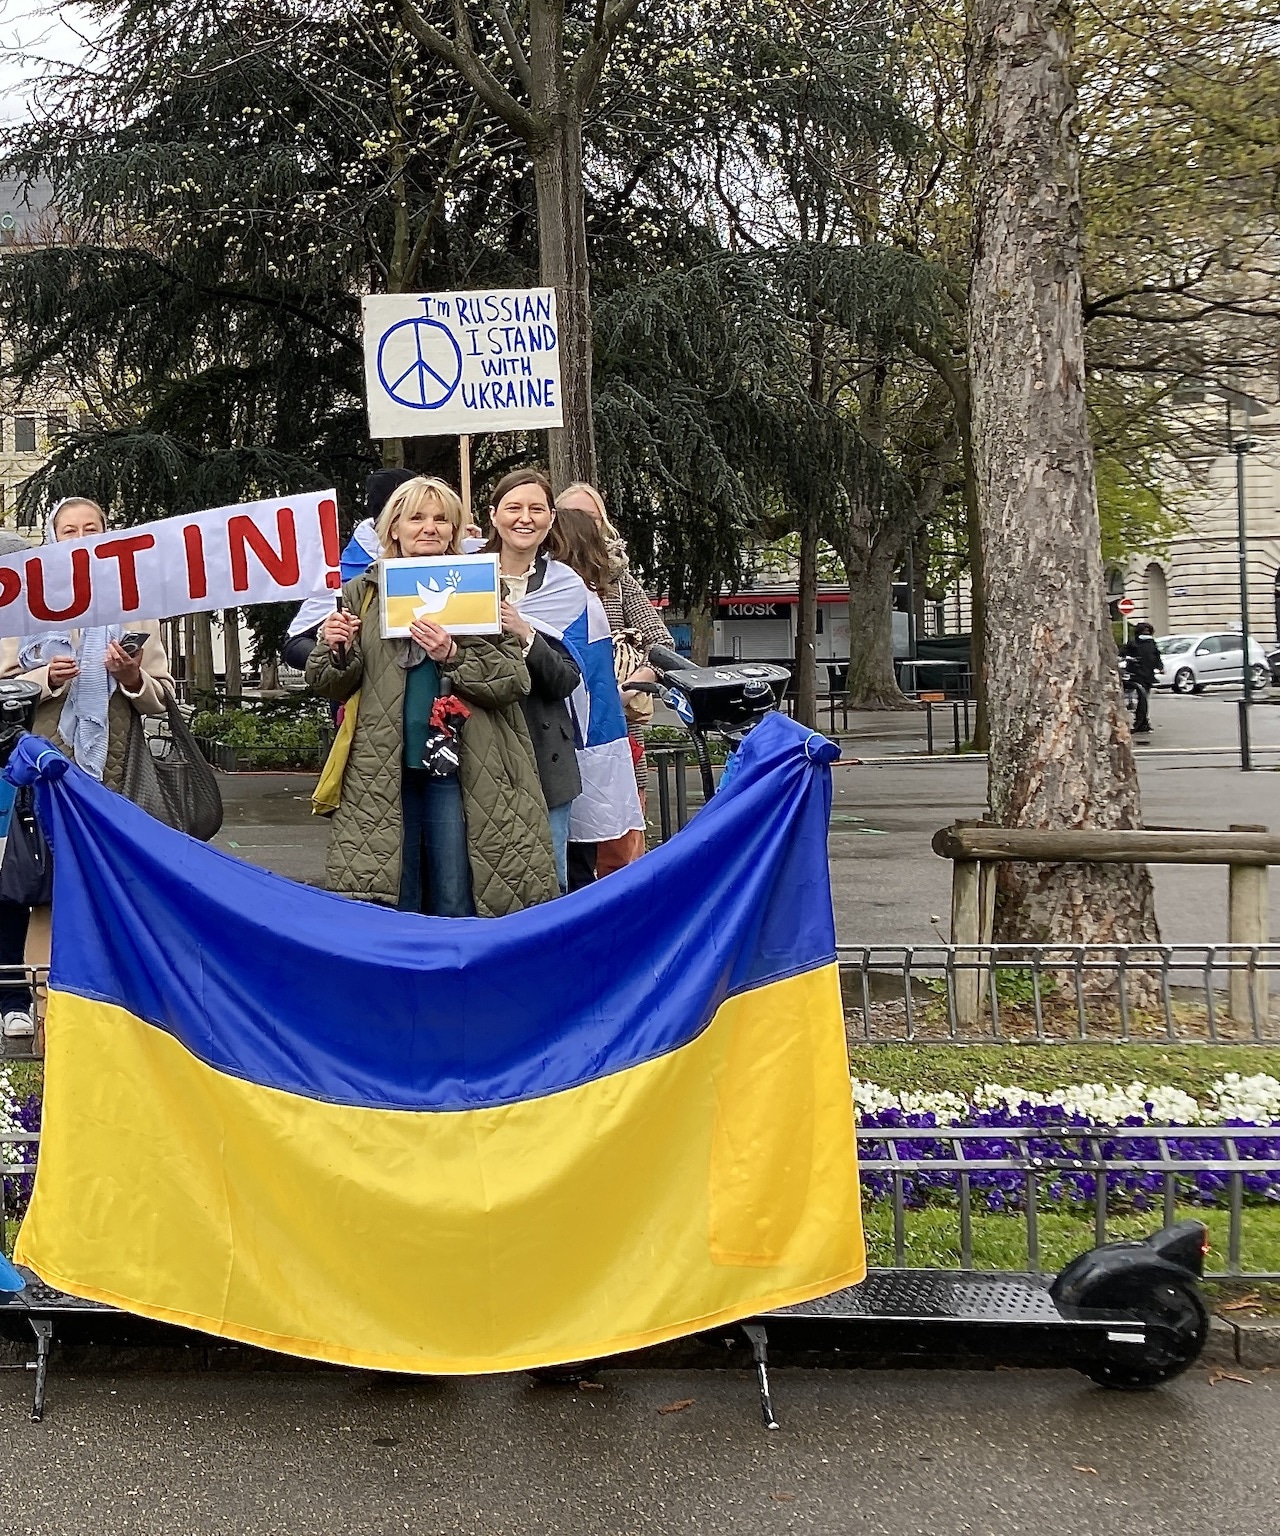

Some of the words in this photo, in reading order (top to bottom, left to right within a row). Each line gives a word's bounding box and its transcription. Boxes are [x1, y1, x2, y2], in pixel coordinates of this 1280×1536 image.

[417, 297, 450, 318] I'm
[456, 293, 551, 326] RUSSIAN
[466, 329, 484, 356] I
[488, 323, 557, 355] STAND
[481, 357, 532, 377] WITH
[461, 378, 556, 410] UKRAINE
[728, 603, 777, 616] KIOSK
